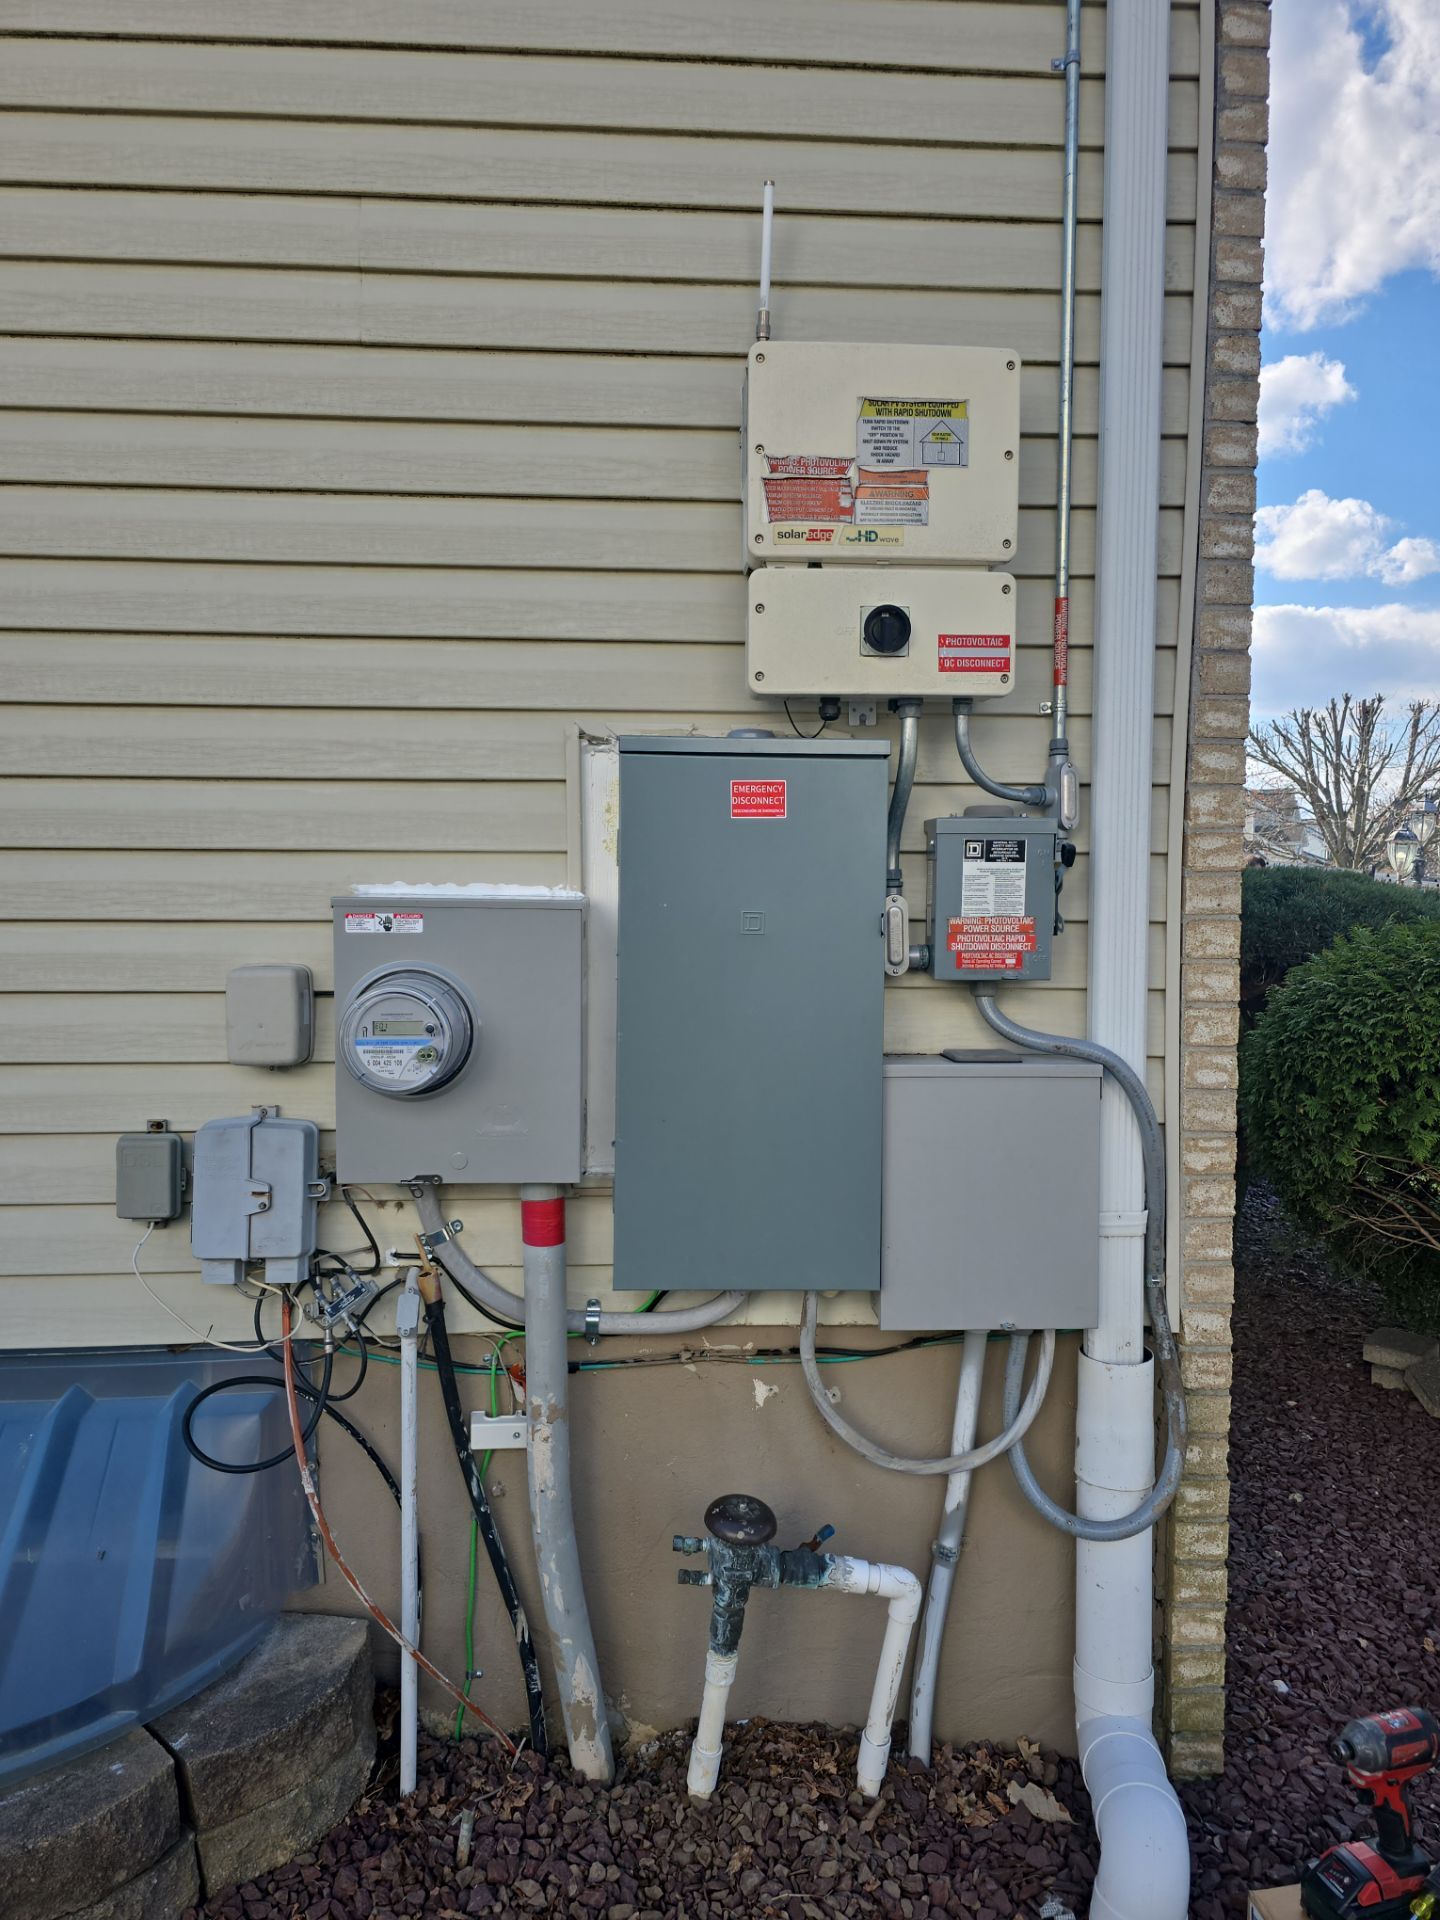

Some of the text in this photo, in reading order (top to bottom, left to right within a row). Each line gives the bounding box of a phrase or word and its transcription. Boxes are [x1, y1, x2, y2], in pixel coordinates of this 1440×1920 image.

[876, 408, 952, 418] WITH RAPID SHUTDOWN
[778, 466, 838, 475] POWER SOURCE
[875, 490, 914, 498] WARNING
[945, 637, 1004, 646] PHOTOVOLTAIC
[944, 659, 1005, 667] DC DISCONNECT
[733, 785, 783, 793] EMERGENCY
[732, 796, 785, 805] DISCONNECT
[950, 917, 1034, 925] WARNING: PHOTOVOLTAIC
[963, 925, 1020, 933] POWER SOURCE
[957, 934, 1026, 943] PHOTOVOLTAIC RAPID
[951, 943, 1032, 951] SHUTDOWN DISCONNECT
